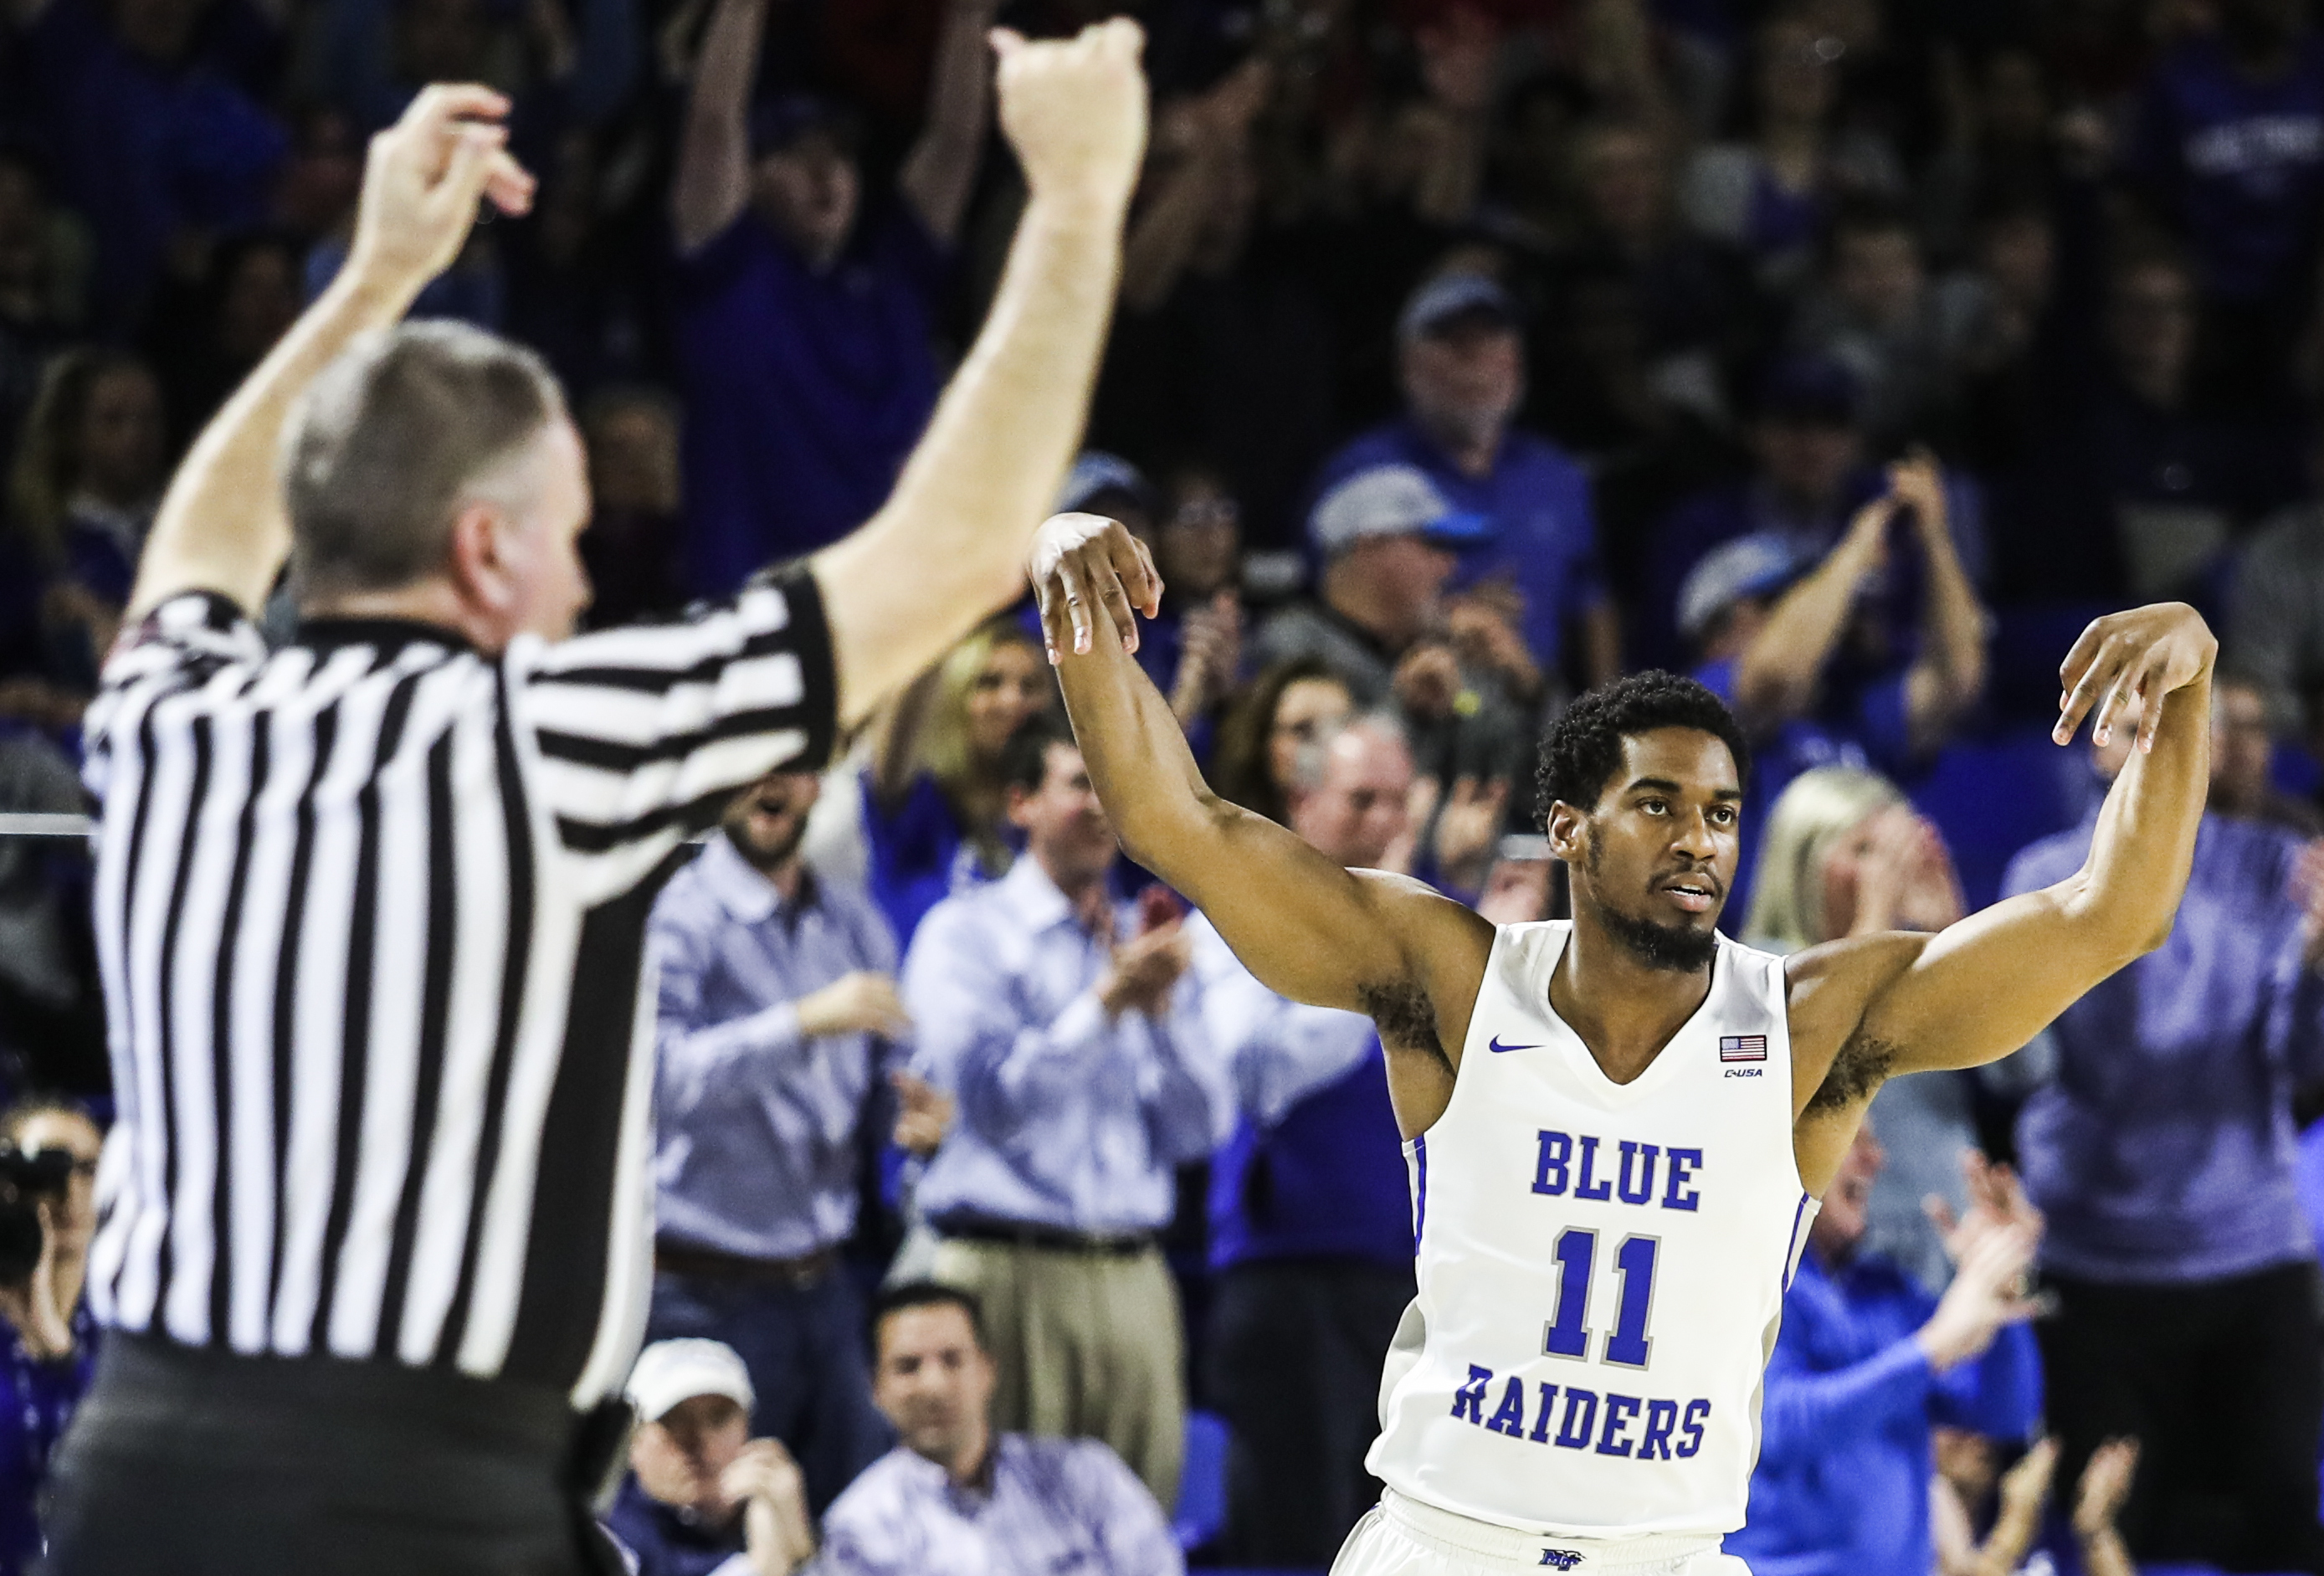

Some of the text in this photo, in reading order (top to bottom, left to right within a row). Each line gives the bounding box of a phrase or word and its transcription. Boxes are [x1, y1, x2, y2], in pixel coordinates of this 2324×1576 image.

[1531, 1129, 1703, 1213] BLUE
[1541, 1224, 1662, 1371] 11
[1450, 1363, 1711, 1461] RAIDERS
